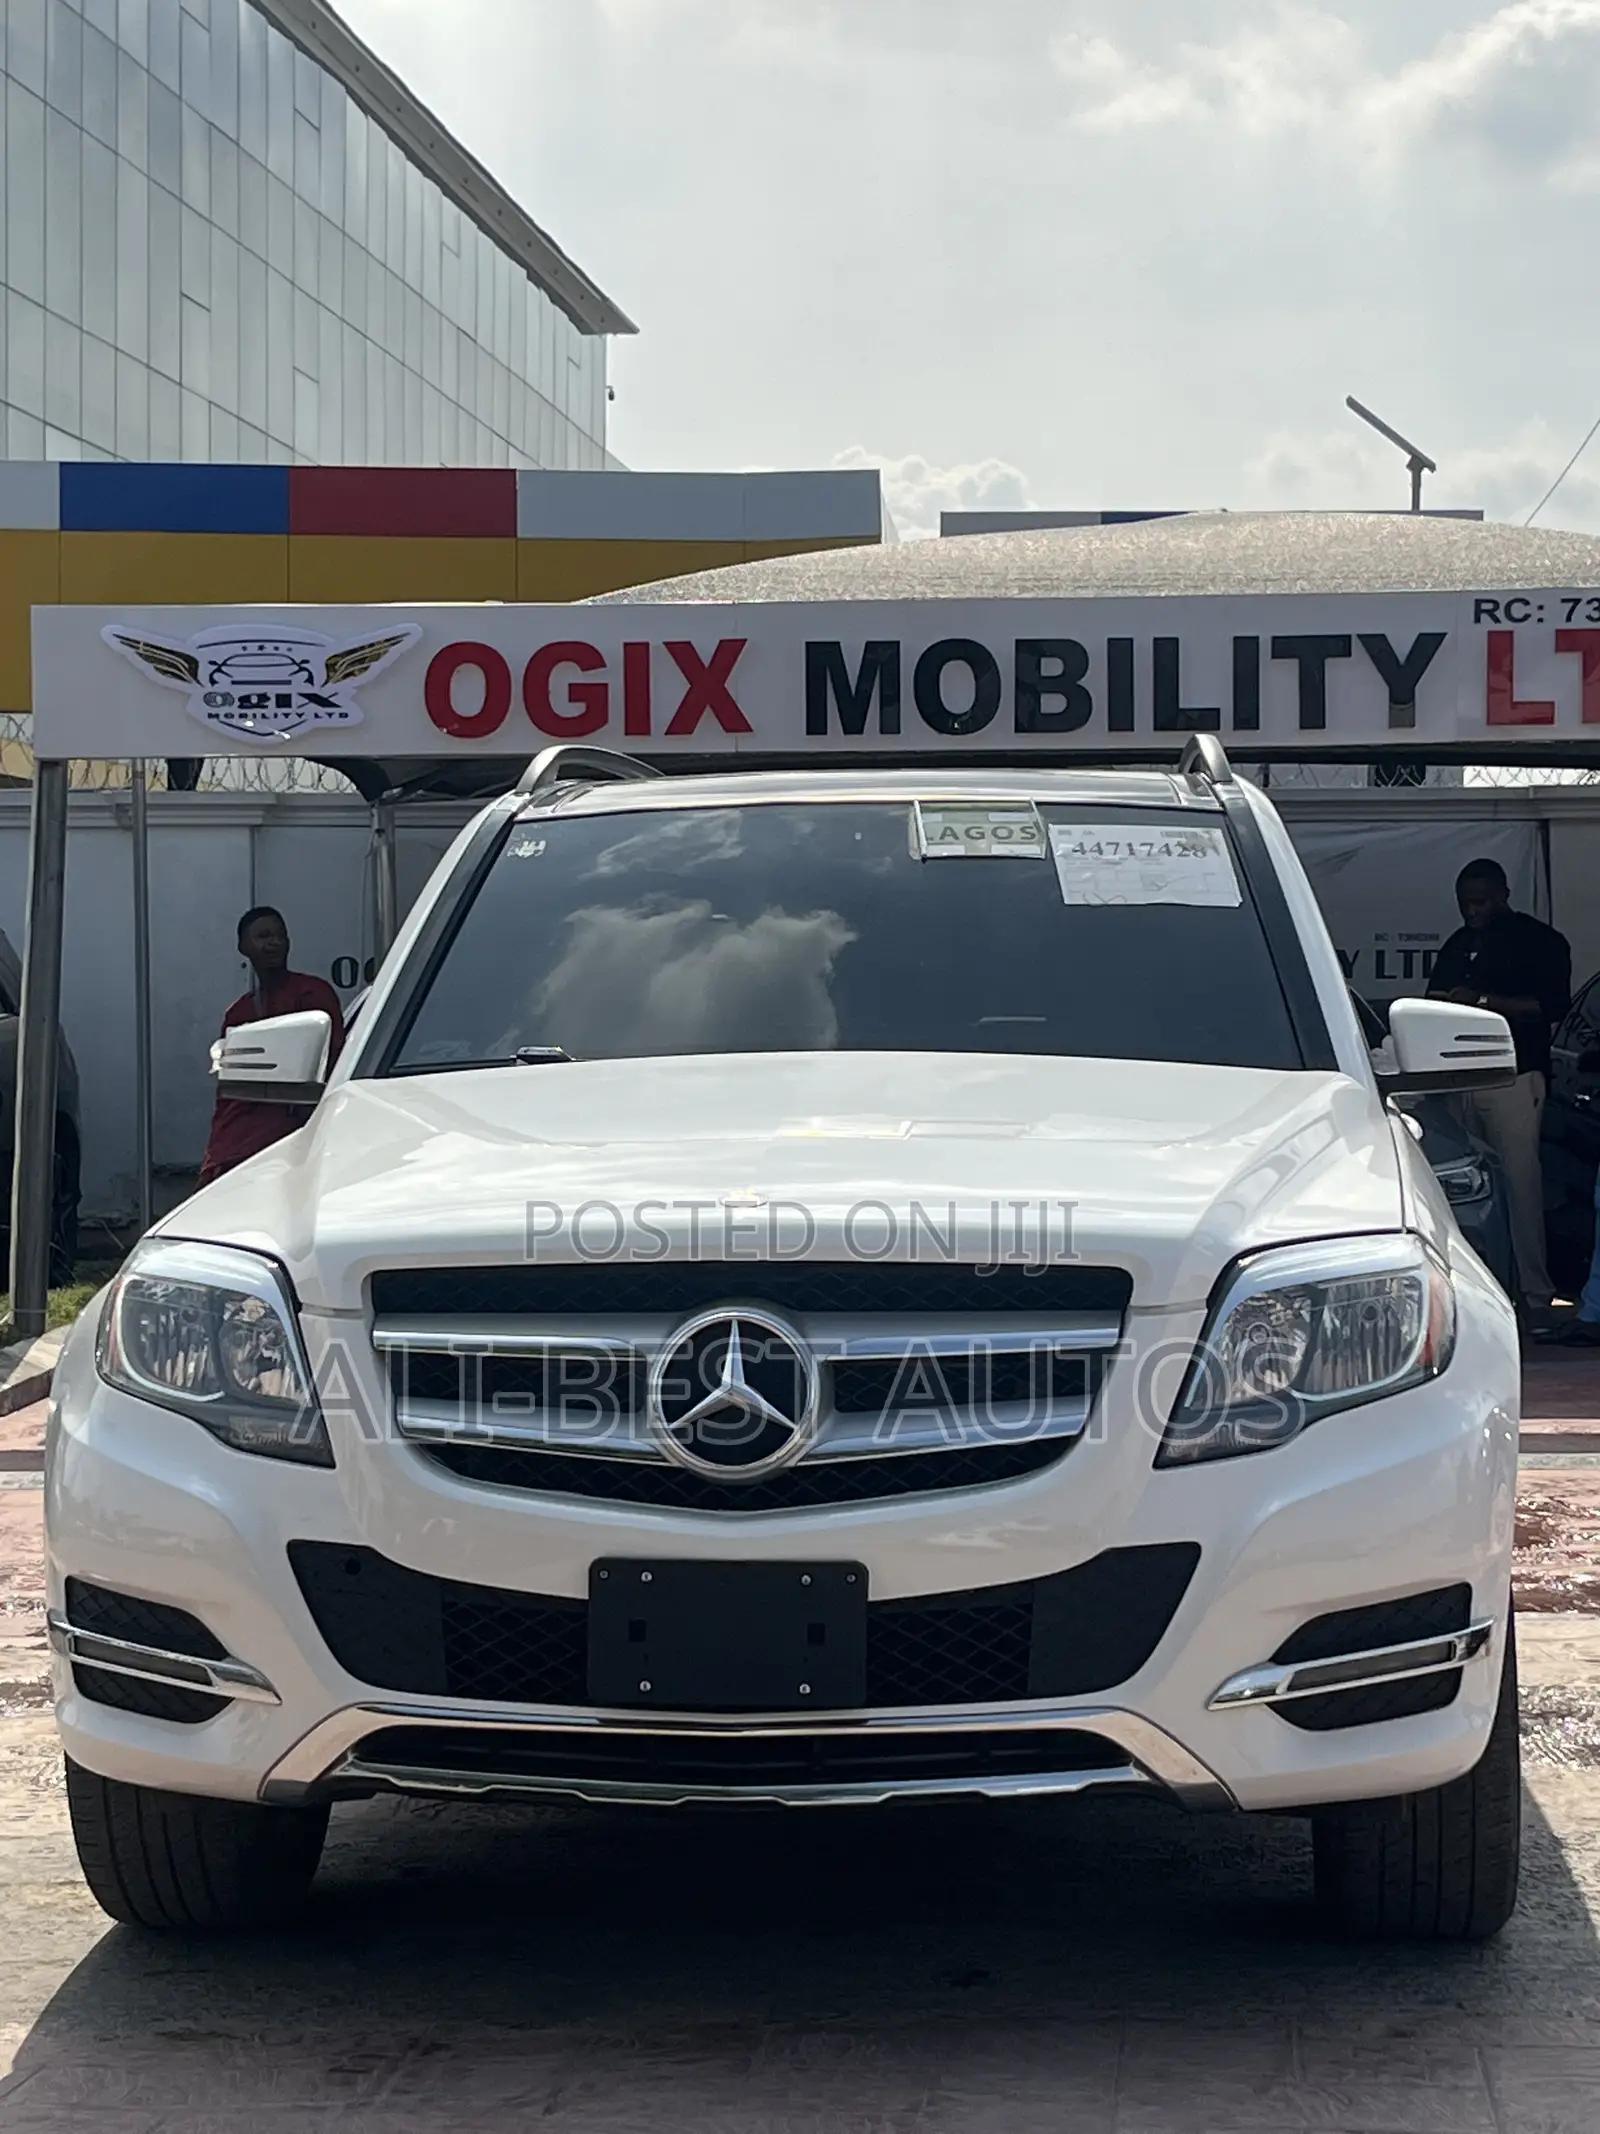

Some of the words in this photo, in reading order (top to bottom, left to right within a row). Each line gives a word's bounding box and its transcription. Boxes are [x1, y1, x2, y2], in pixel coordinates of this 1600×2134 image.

[1474, 598, 1545, 624] RC:
[424, 638, 754, 739] OGIX
[804, 632, 1448, 736] MOBILITY
[207, 712, 305, 720] MOBILITY
[314, 712, 349, 720] LTD
[926, 825, 1037, 841] AGOS
